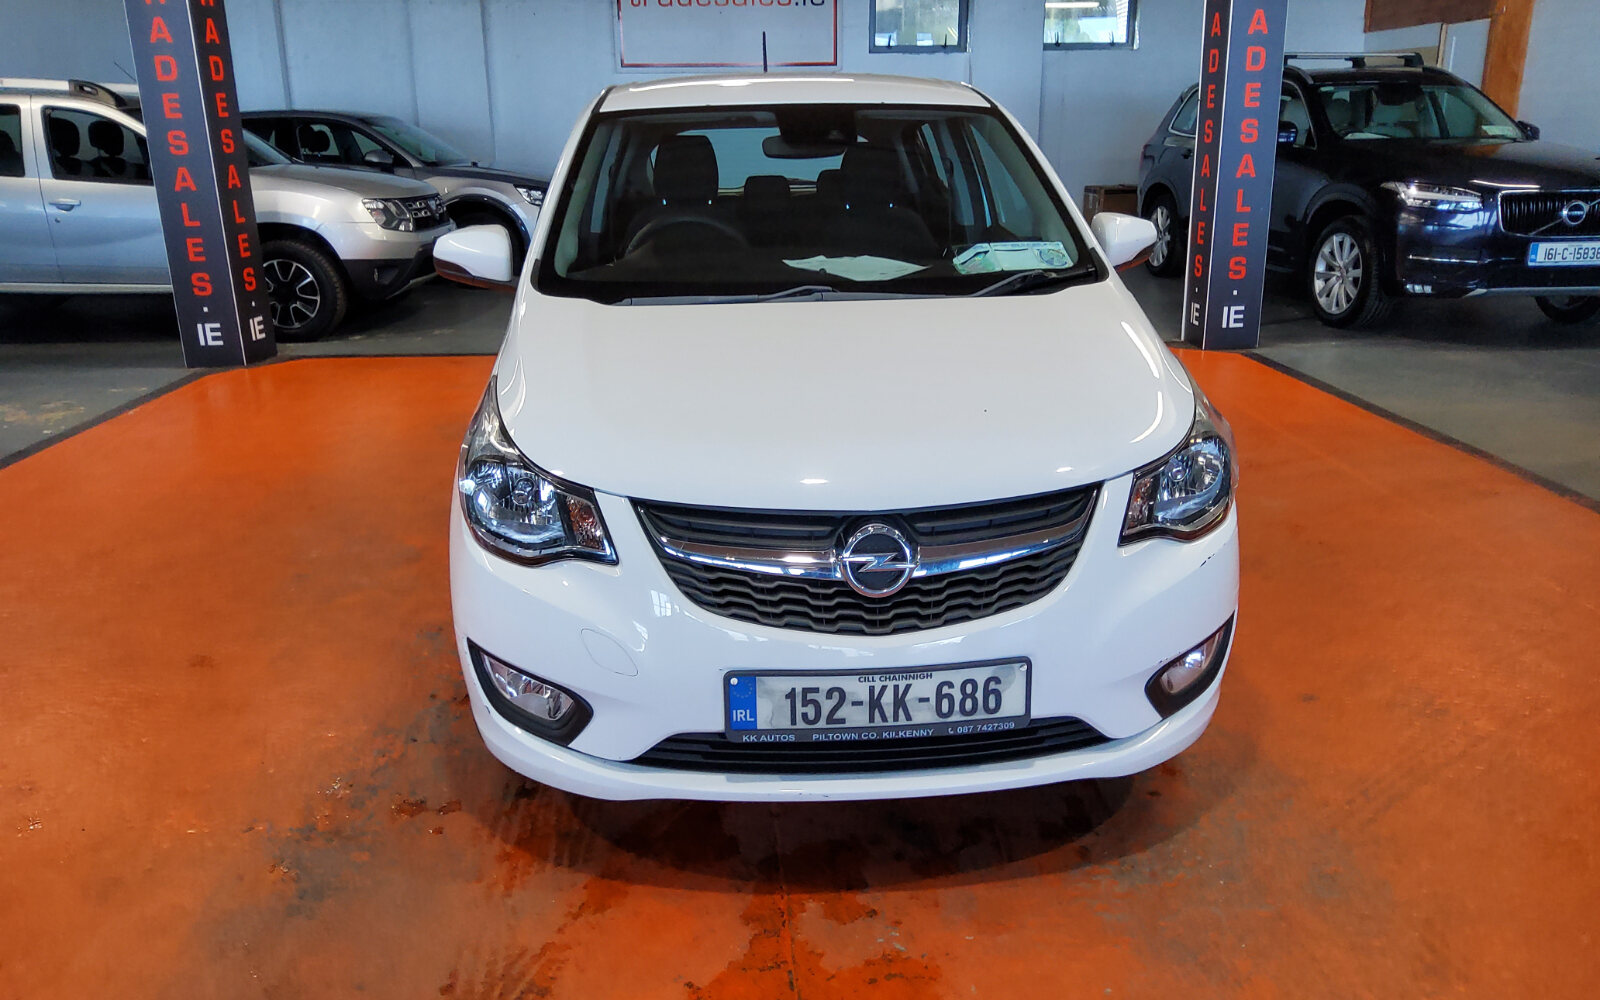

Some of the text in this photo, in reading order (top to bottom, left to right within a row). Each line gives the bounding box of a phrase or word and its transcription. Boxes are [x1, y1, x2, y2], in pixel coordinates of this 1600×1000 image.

[144, 0, 224, 346] ADESALES.IE
[200, 0, 267, 342] ADESALES.IE
[879, 672, 933, 682] CHAINNIGH
[732, 709, 755, 722] IRL
[785, 676, 1003, 726] 152-KK-686
[742, 722, 1015, 742] KK AUTOS PILTOWN CO. KILKENNY 087 7427309
